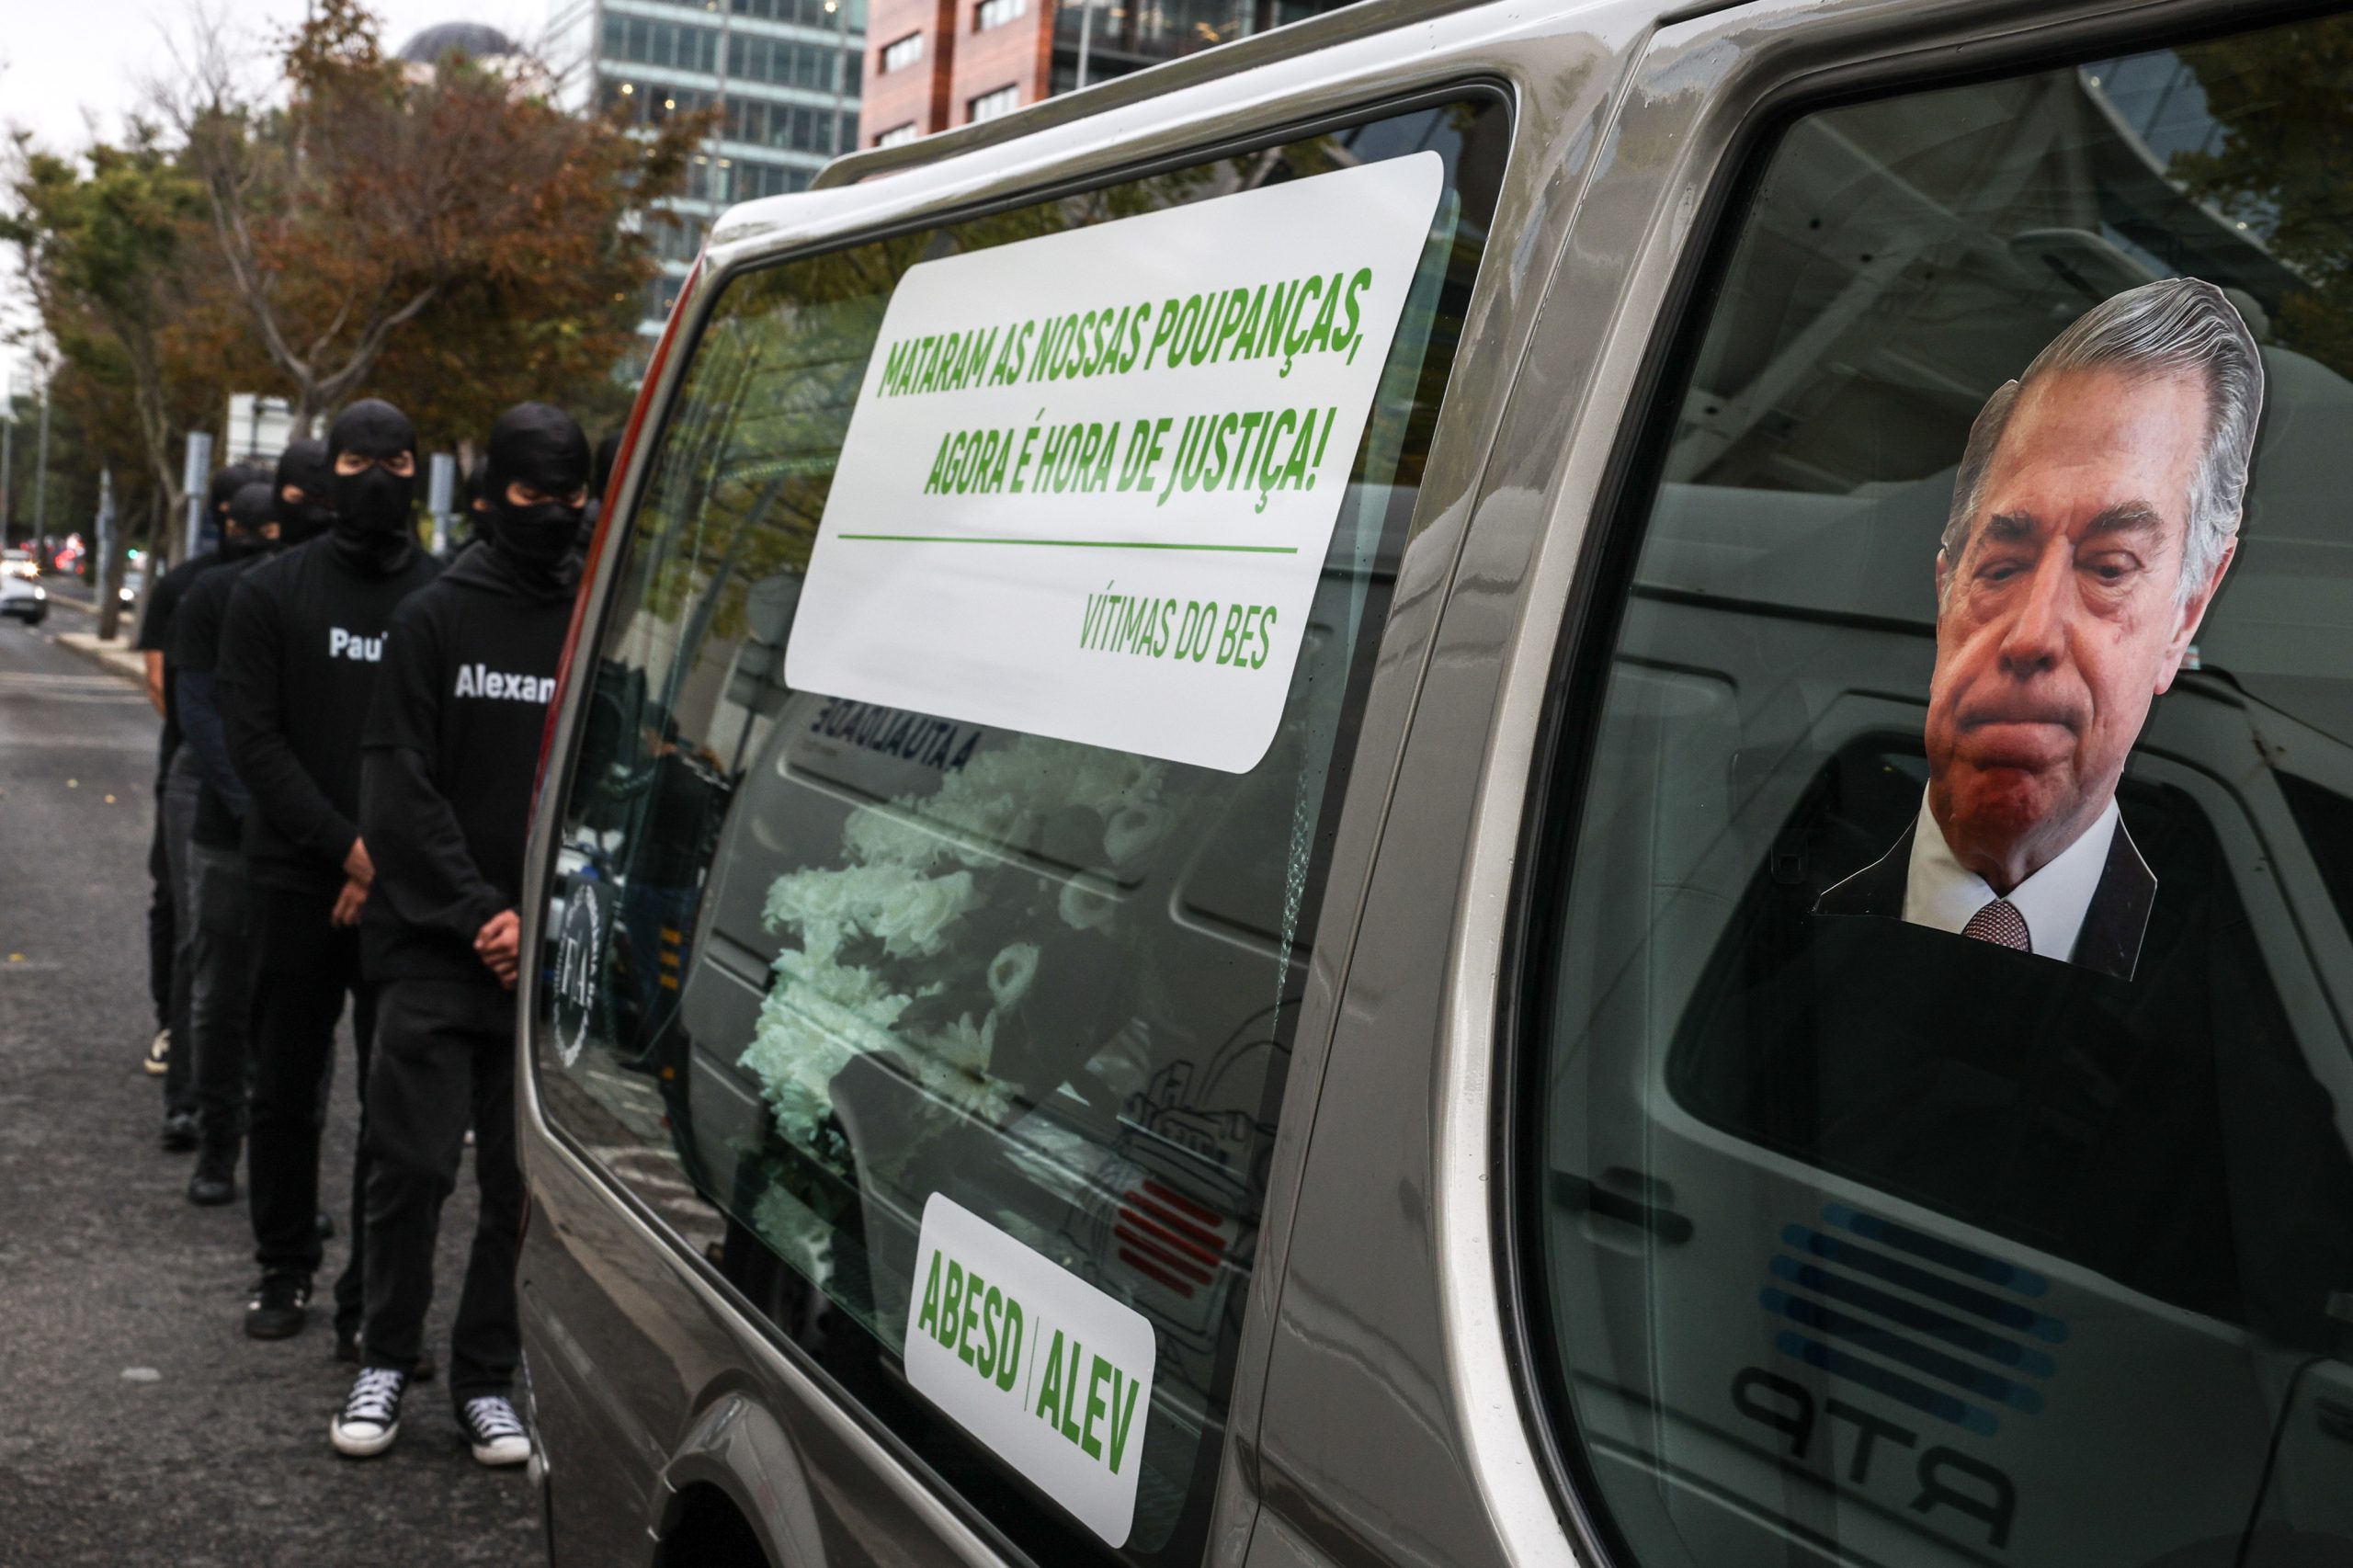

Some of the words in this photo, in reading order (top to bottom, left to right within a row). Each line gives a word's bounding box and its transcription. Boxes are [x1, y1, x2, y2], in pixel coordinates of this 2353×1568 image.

[878, 327, 997, 397] MATARAM
[989, 320, 1035, 386] AS
[1028, 302, 1152, 382] NOSSAS
[1143, 267, 1372, 378] POUPANÇAS,
[923, 428, 1015, 495] AGORA
[1009, 408, 1045, 494] É
[1032, 421, 1121, 494] HORA
[1117, 416, 1175, 492] DE
[1156, 406, 1336, 515] JUSTIÇA!
[328, 626, 389, 663] Pau
[1080, 580, 1176, 660] VÍTIMAS
[1174, 600, 1219, 663] DO
[1217, 602, 1278, 670] BES
[453, 662, 557, 704] Alexan
[917, 1250, 1024, 1392] ABESD
[1036, 1330, 1141, 1475] ALEV
